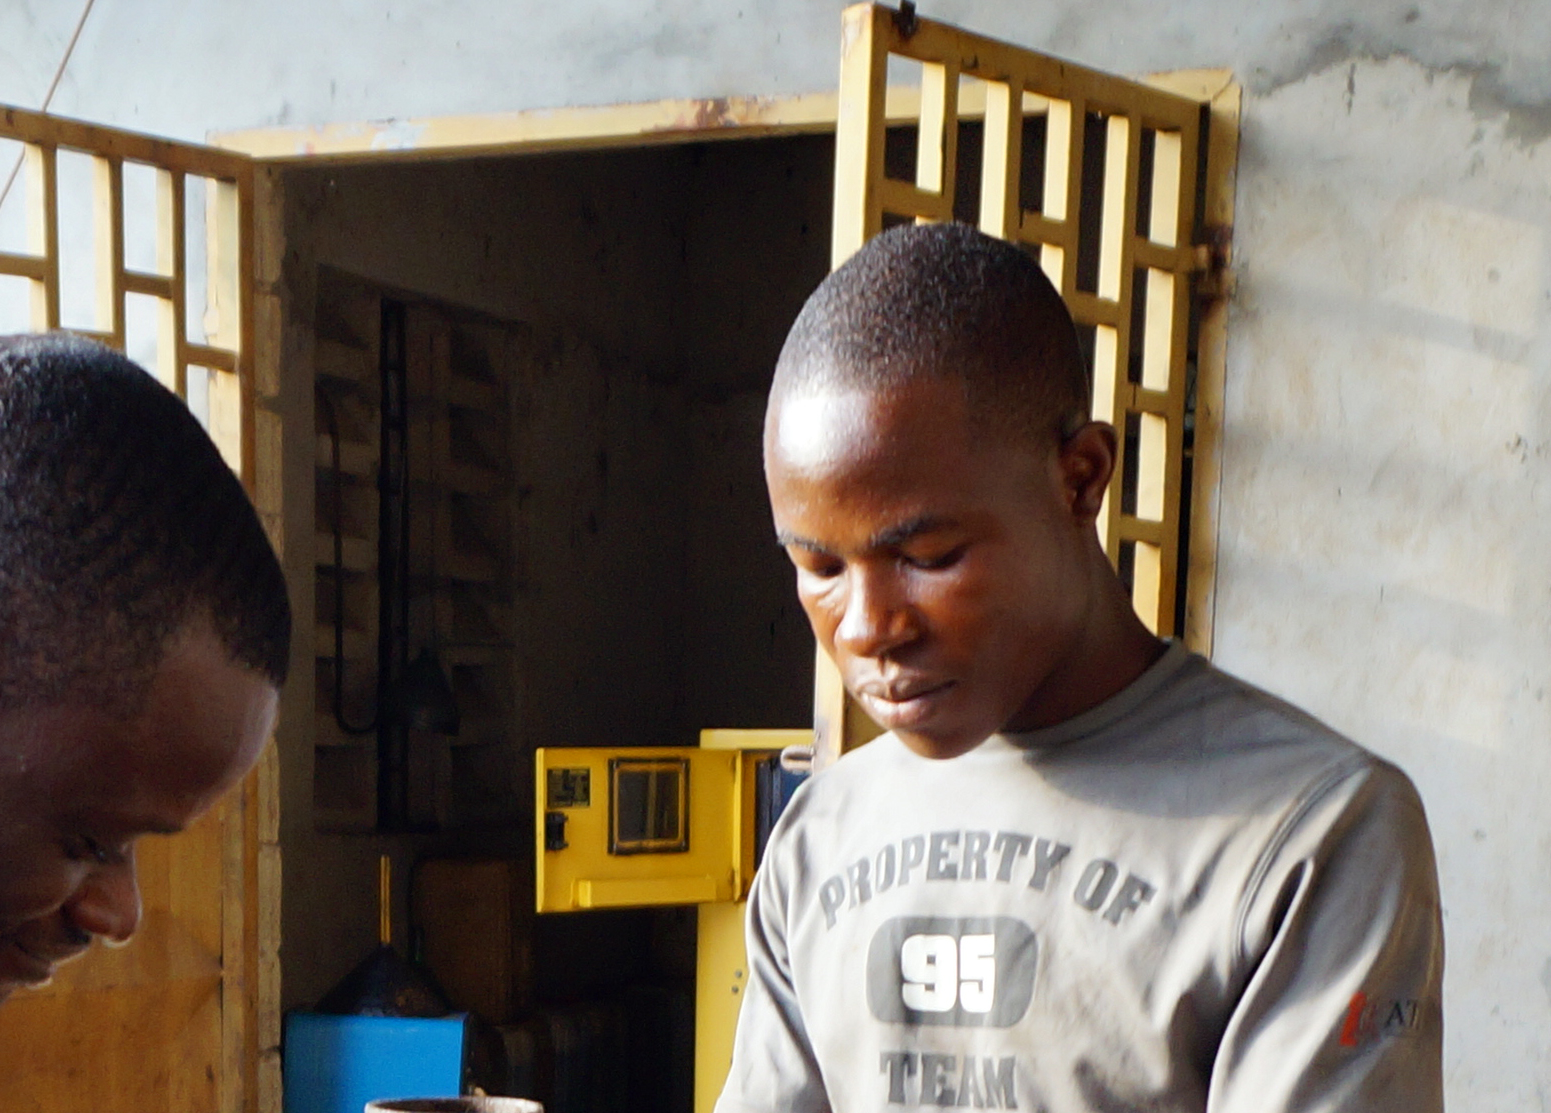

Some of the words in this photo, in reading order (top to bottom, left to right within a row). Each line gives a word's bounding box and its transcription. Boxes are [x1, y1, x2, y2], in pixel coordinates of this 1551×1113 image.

[819, 830, 1072, 931] PROPERTY
[1073, 858, 1159, 926] OF
[901, 934, 996, 1013] 95
[879, 1052, 1019, 1110] TEAM
